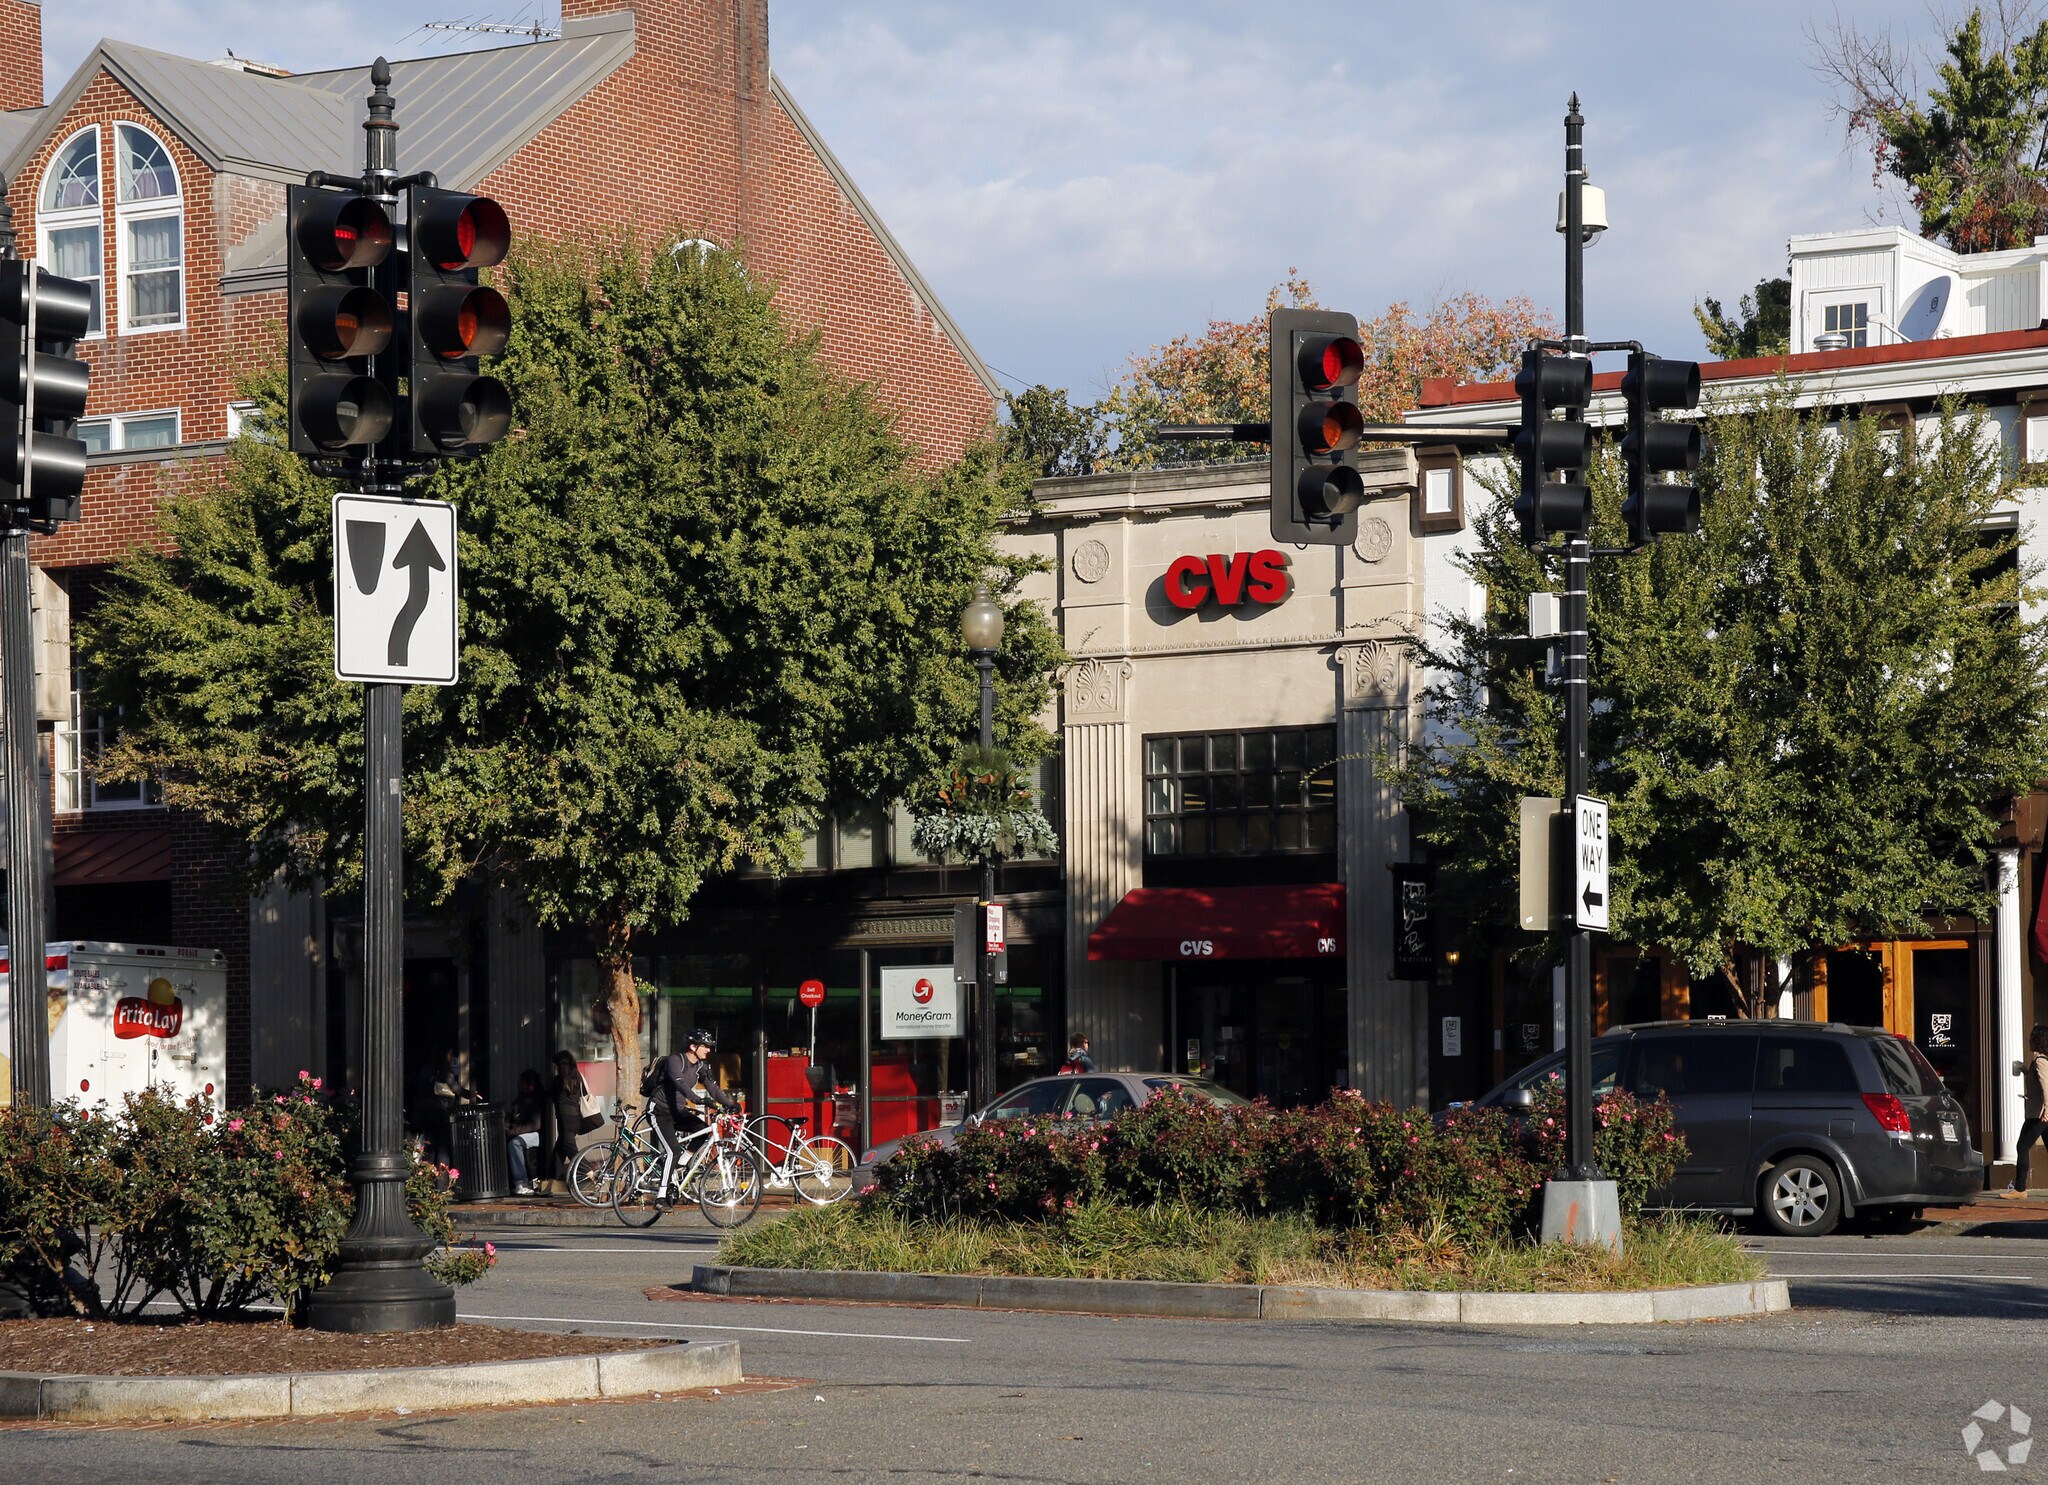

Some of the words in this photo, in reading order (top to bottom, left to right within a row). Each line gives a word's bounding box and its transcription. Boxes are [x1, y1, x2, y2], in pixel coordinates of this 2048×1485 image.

[1165, 549, 1289, 609] CVS
[1582, 808, 1602, 840] ONE
[1581, 843, 1603, 874] WAY
[1180, 940, 1213, 956] CVS
[1317, 938, 1336, 953] CVS
[895, 1010, 952, 1023] MoneyGram
